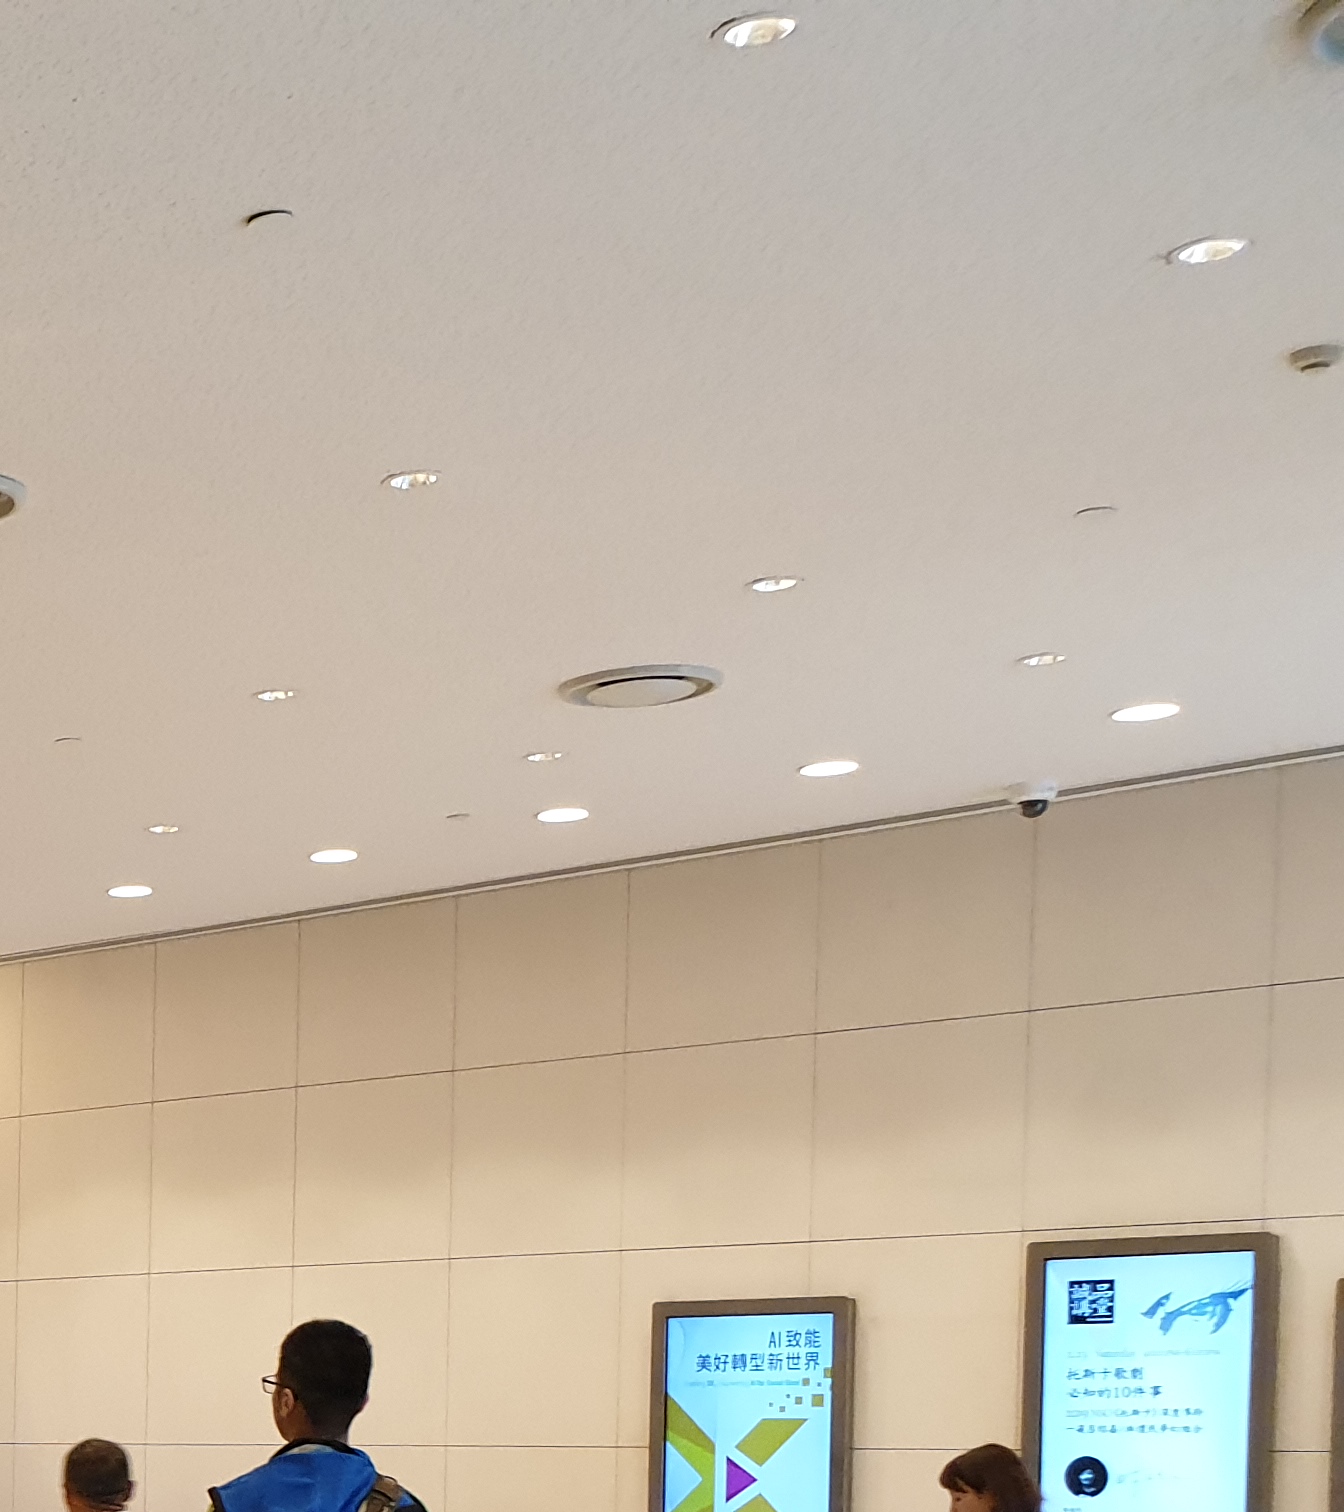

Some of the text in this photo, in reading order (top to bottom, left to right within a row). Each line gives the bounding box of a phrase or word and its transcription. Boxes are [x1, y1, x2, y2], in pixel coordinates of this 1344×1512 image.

[768, 1328, 822, 1349] AI 致能
[695, 1351, 820, 1373] 美好轉型新世界
